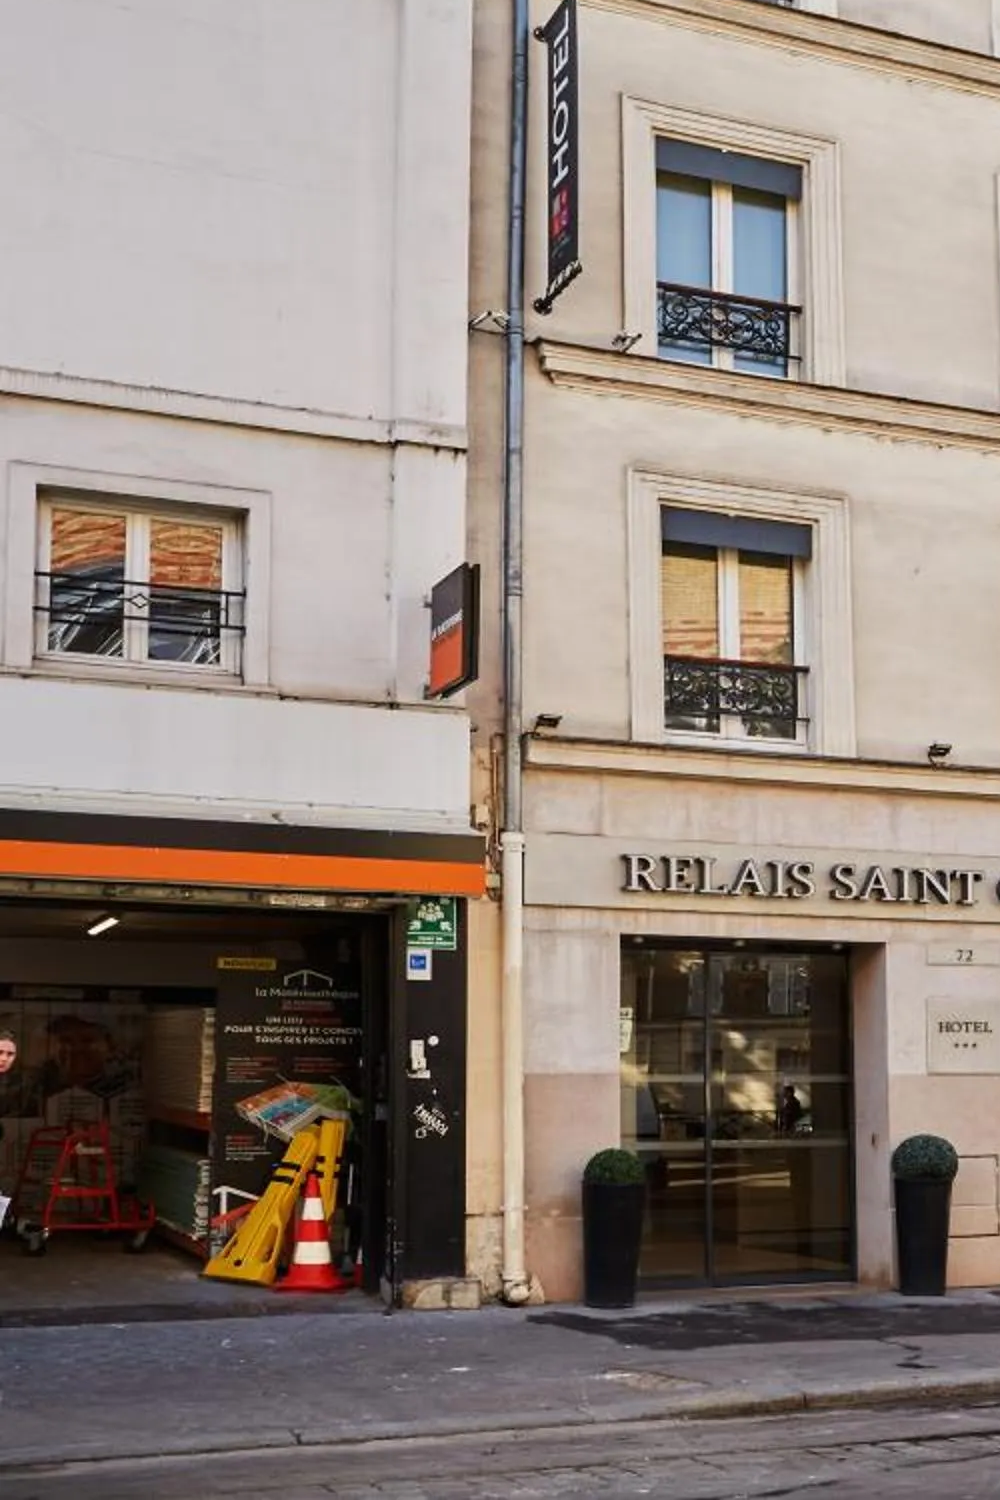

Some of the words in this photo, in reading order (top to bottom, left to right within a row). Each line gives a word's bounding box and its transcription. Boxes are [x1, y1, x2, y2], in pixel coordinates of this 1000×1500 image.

[552, 7, 570, 190] HOTEL
[621, 854, 816, 899] RELAIS
[829, 863, 983, 906] SAINT
[956, 949, 973, 962] 72
[938, 1021, 993, 1033] HOTEL
